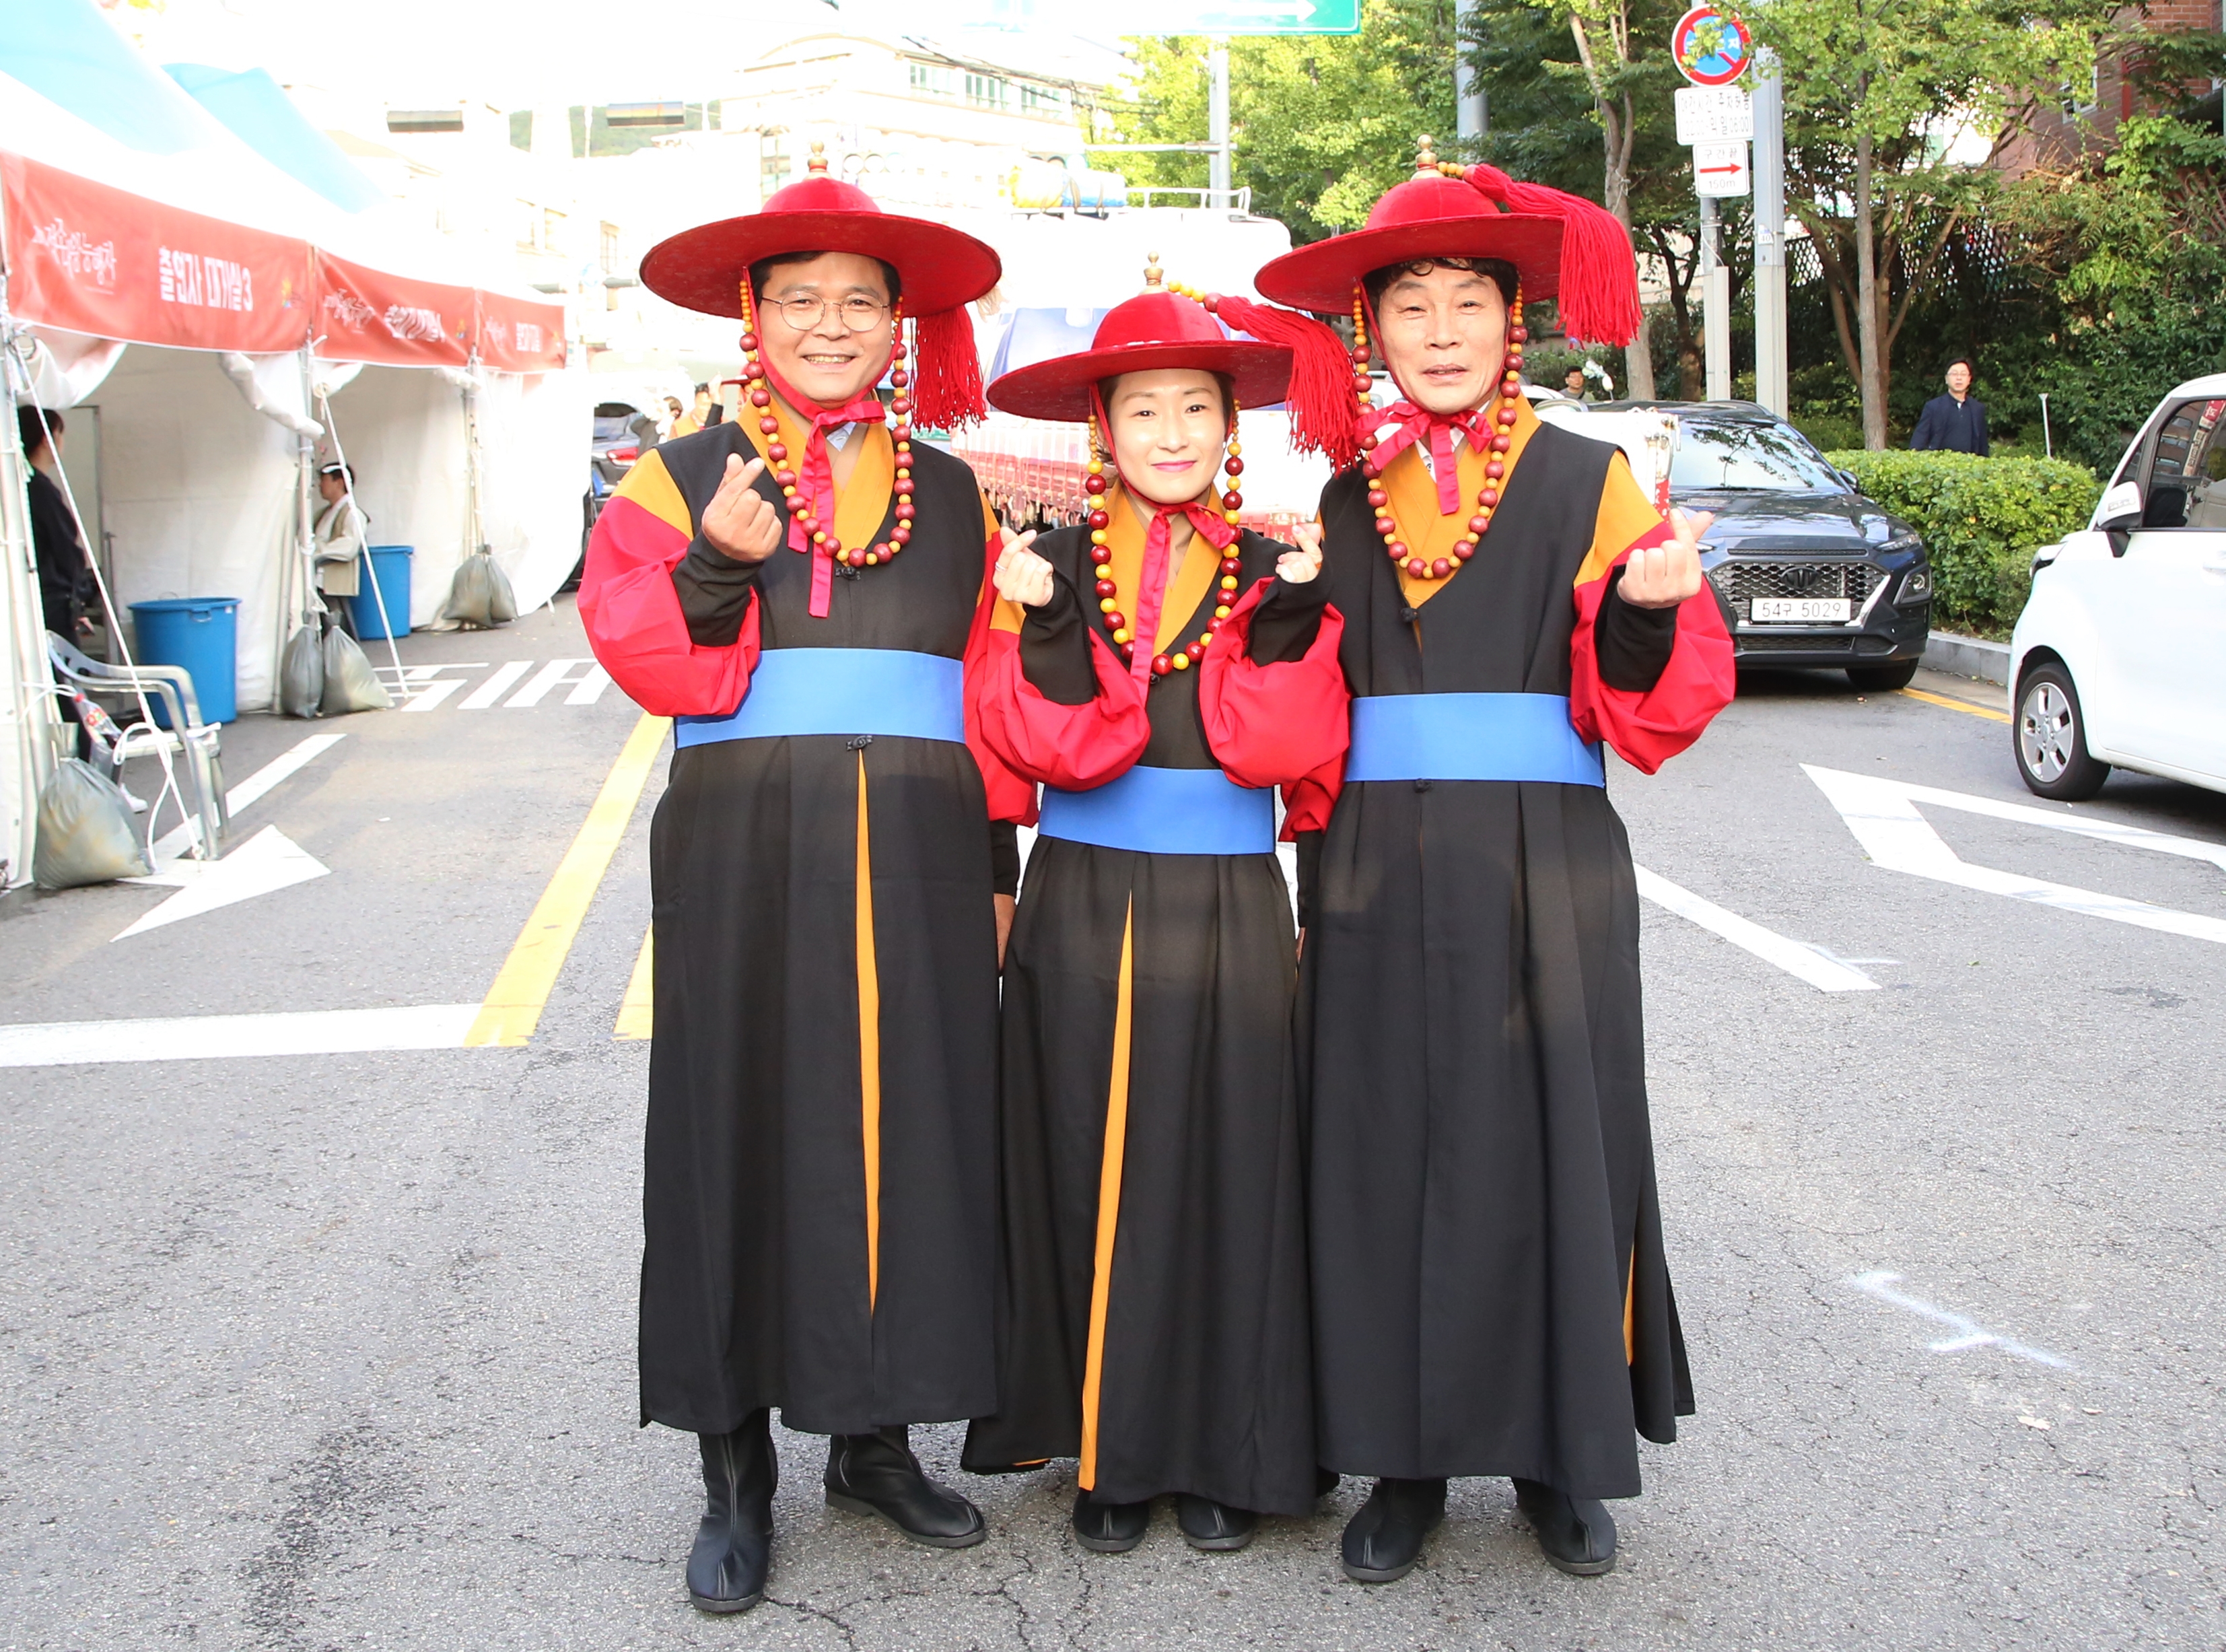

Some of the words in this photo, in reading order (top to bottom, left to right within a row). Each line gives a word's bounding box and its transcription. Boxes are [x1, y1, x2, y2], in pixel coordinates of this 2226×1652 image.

[1708, 178, 1735, 189] 150m
[158, 244, 203, 307] 출연자
[1762, 603, 1792, 617] 54구
[1801, 603, 1842, 617] 5029
